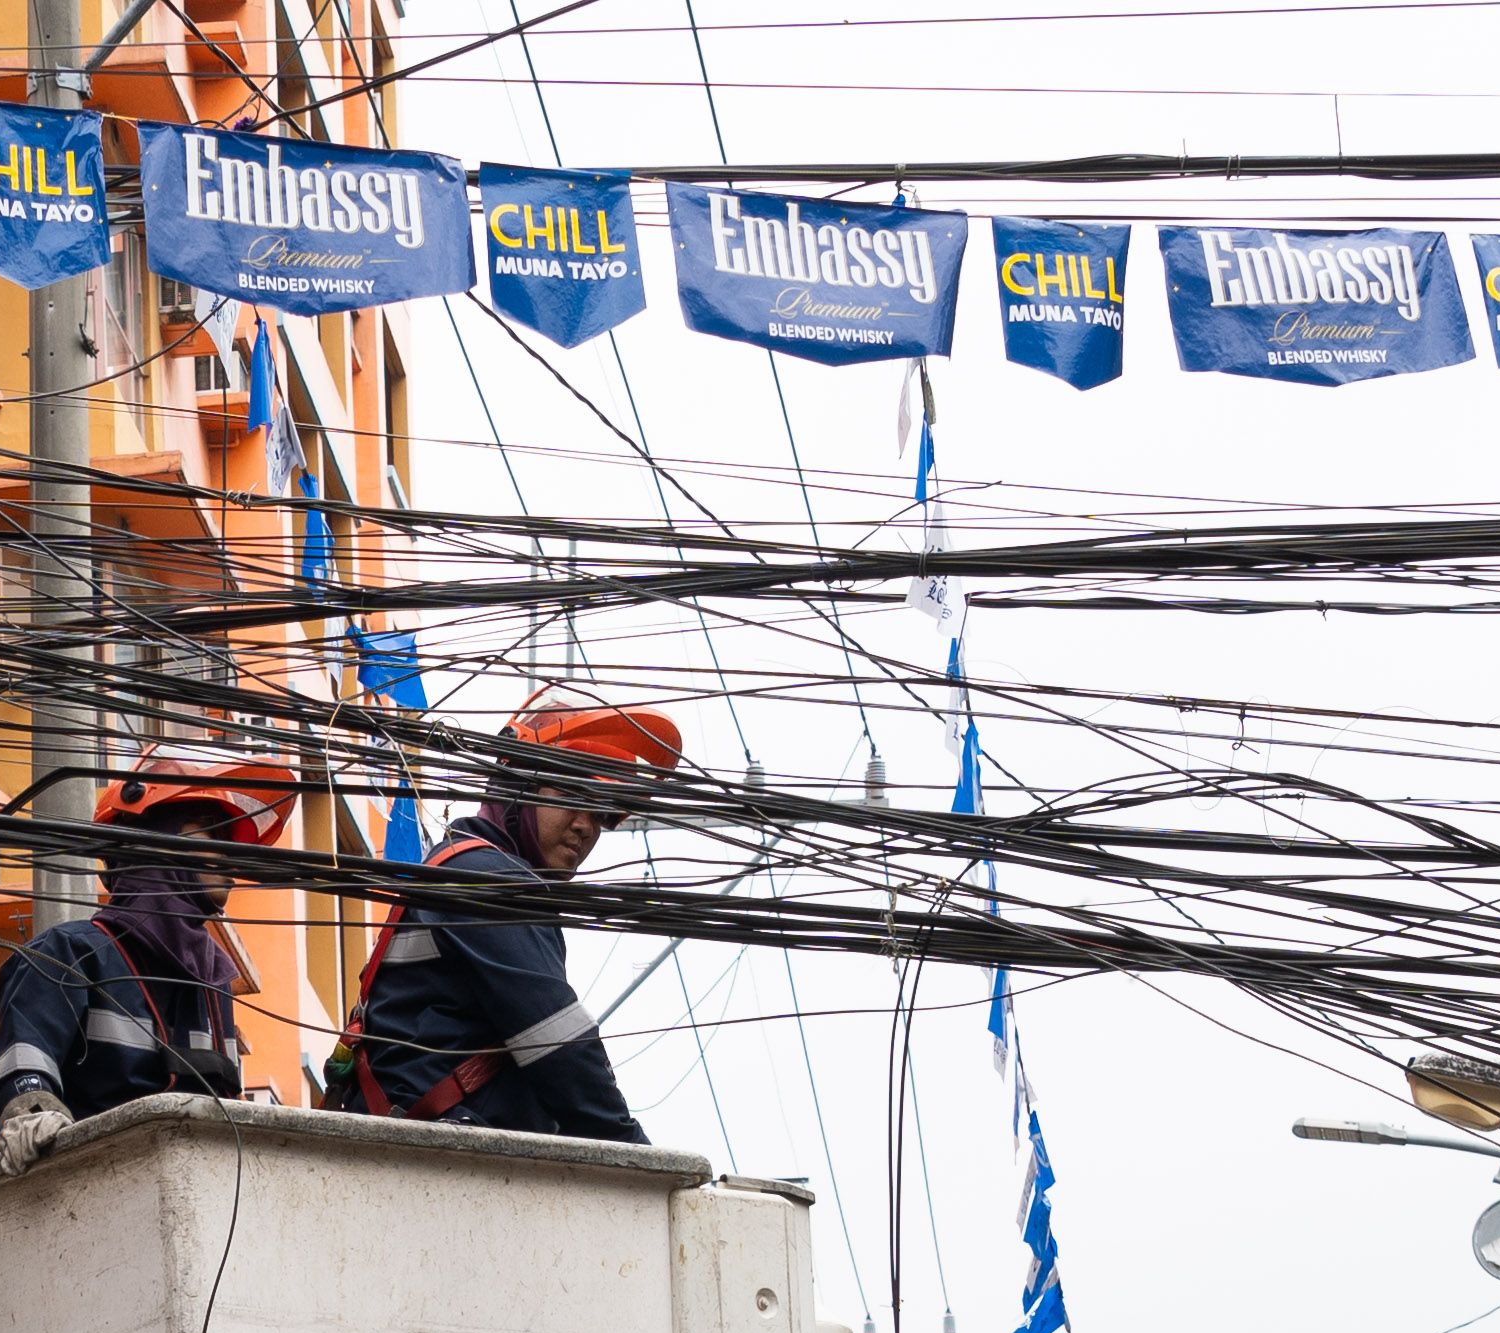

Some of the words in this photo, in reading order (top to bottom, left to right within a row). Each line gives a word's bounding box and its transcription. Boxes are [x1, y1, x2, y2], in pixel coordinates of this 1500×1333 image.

[182, 133, 425, 249] Embassy
[32, 201, 94, 223] TAYO
[490, 204, 625, 254] CHILL
[241, 235, 365, 270] Premium
[708, 193, 938, 304] Embassy
[238, 273, 309, 292] BLENDED
[311, 276, 375, 295] WHISKY
[496, 256, 564, 279] MUNA
[567, 260, 628, 281] TAYO
[1001, 252, 1123, 304] CHILL
[1197, 230, 1422, 320] Embassy
[770, 286, 885, 320] Premium
[1009, 304, 1077, 324] MUNA
[1079, 306, 1122, 331] TAYO
[769, 322, 835, 341] BLENDED
[836, 326, 895, 346] WHISKY
[1267, 310, 1375, 344] Premium
[1267, 349, 1333, 366] BLENDED
[1333, 348, 1388, 363] WHISKY
